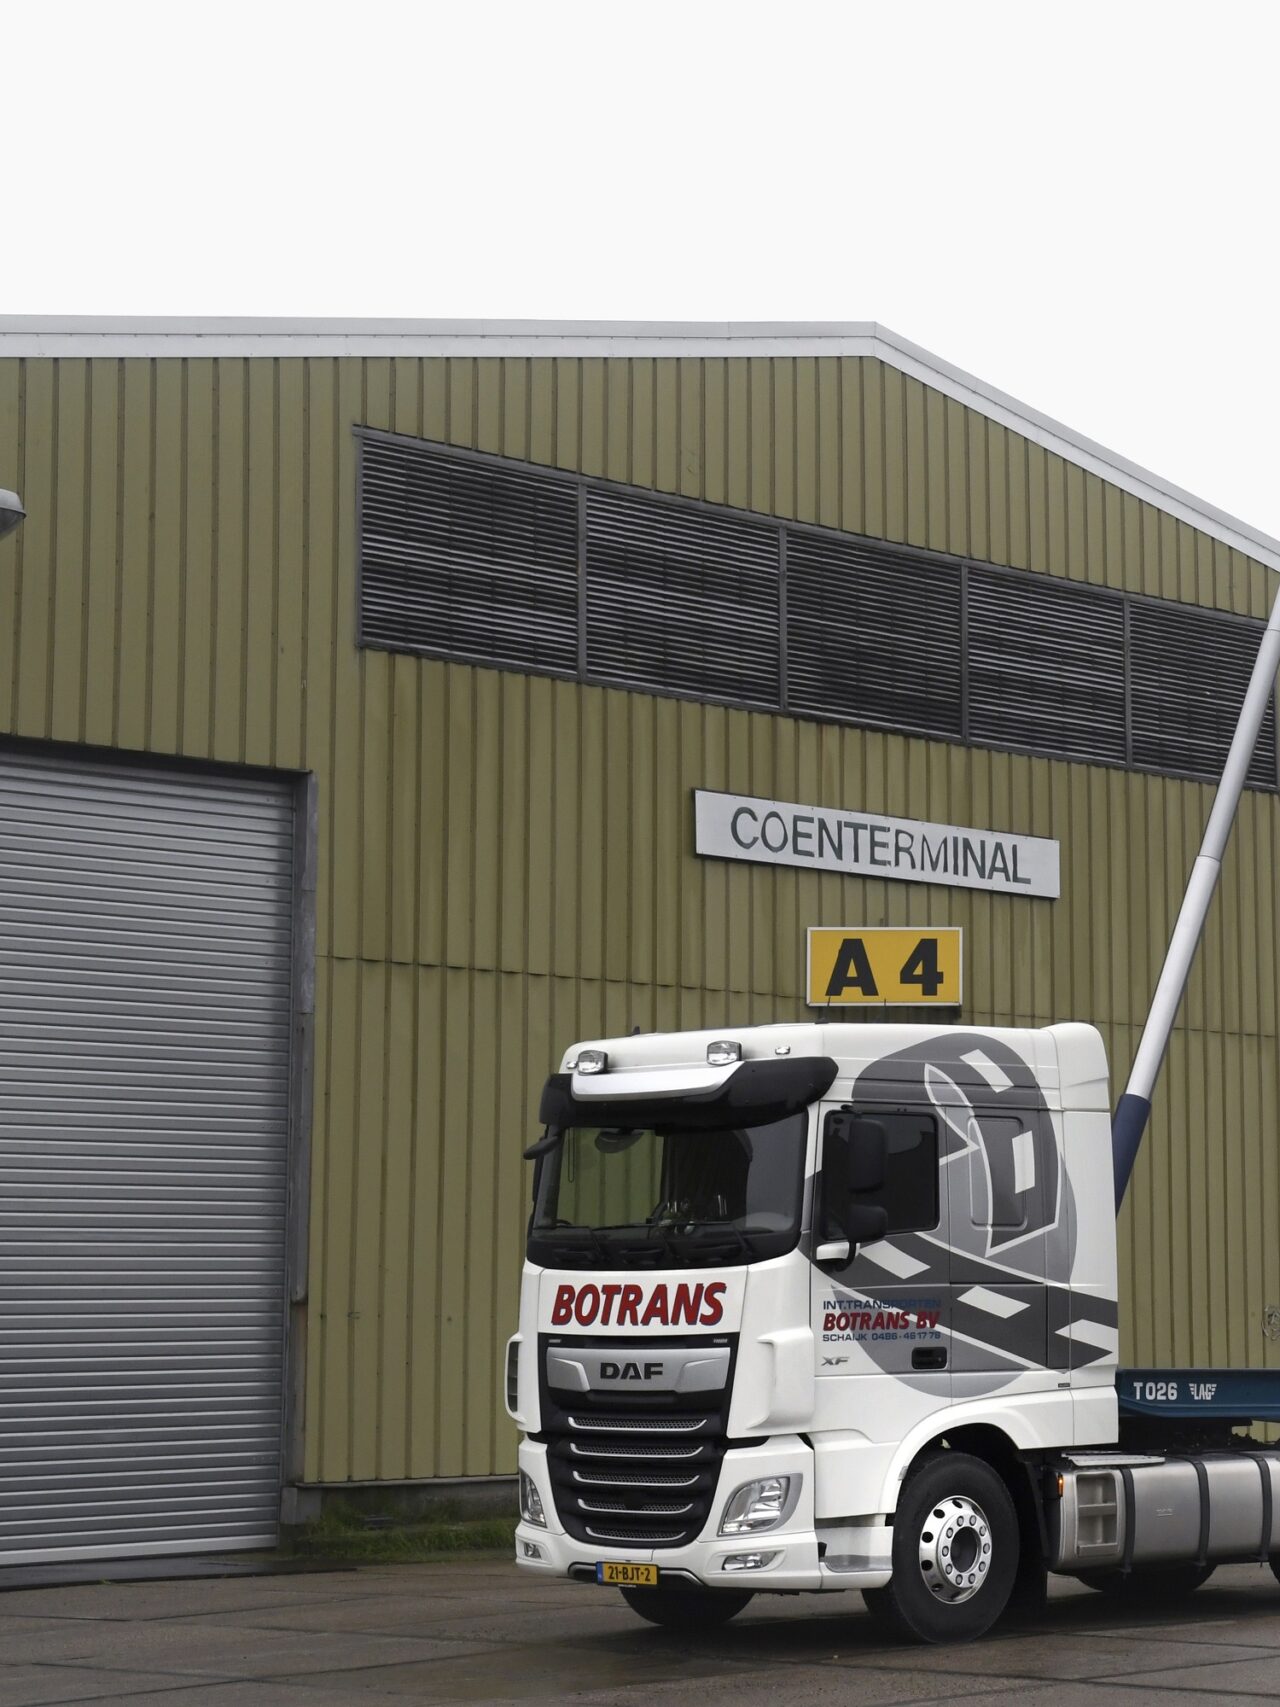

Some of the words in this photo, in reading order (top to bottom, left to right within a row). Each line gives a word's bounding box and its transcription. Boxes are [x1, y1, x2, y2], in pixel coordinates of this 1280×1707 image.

[730, 806, 1032, 885] COENTERMINAL
[825, 938, 879, 996] A
[900, 938, 944, 996] 4
[551, 1282, 728, 1326] BOTRANS
[823, 1311, 911, 1331] BOTRANS
[916, 1311, 941, 1329] BV
[822, 1332, 868, 1342] SCHAIJK
[820, 1356, 850, 1367] XF
[600, 1362, 664, 1380] DAF
[1190, 1383, 1215, 1400] LAG
[1190, 1383, 1215, 1400] LAG
[607, 1565, 652, 1582] 21-BJT-2
